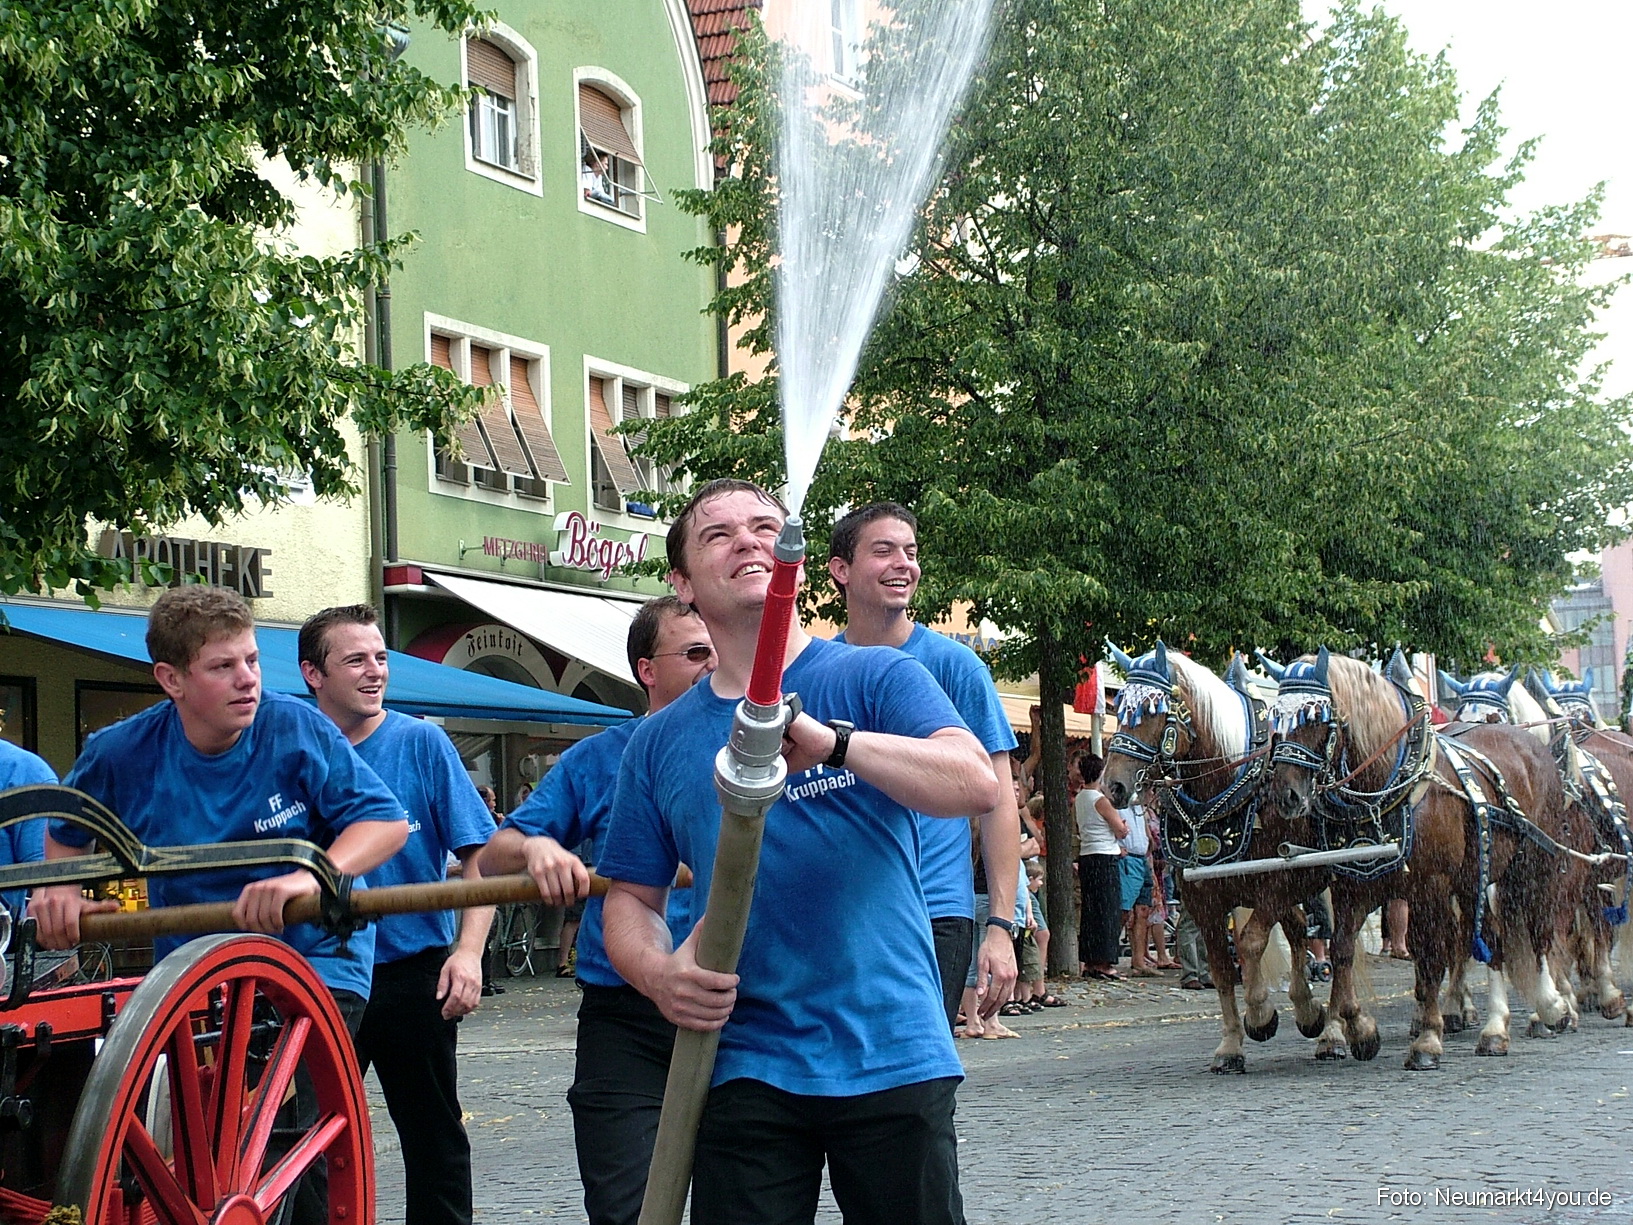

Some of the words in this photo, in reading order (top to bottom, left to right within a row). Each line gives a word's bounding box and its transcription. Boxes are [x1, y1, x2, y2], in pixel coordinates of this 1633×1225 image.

[484, 536, 547, 564] METZGEREI
[562, 511, 649, 581] Bögerl
[104, 529, 274, 598] APOTHEKE
[268, 793, 283, 813] FF
[784, 769, 856, 803] Kruppach
[254, 800, 307, 834] Kruppach
